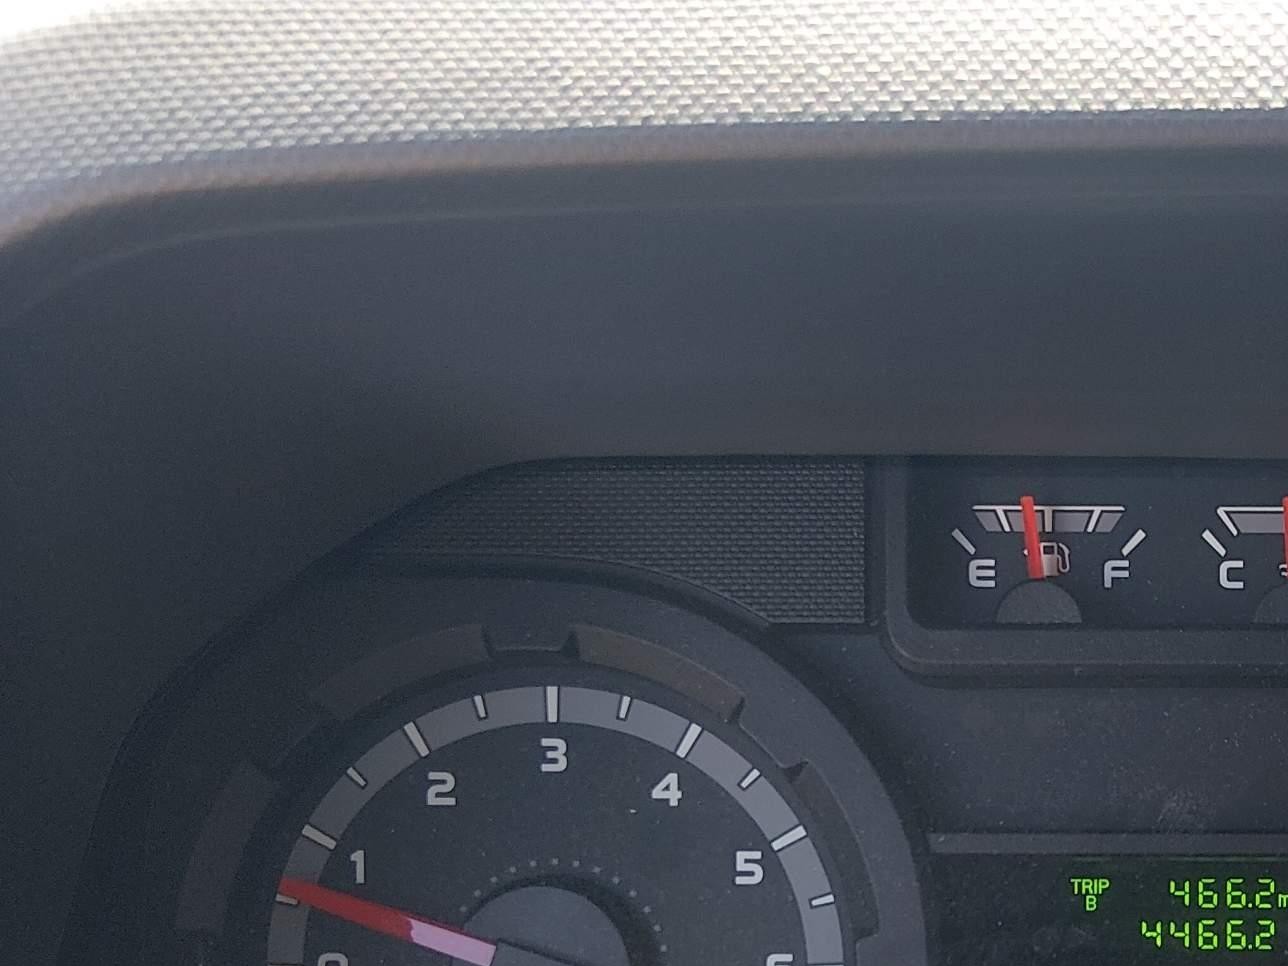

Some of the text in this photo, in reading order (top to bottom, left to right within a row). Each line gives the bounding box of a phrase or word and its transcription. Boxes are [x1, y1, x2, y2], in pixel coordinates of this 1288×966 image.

[969, 560, 1130, 588] E F
[1219, 560, 1244, 589] C
[541, 738, 568, 772] 3
[426, 772, 457, 806] 2
[651, 773, 682, 806] 4
[350, 850, 365, 884] 1
[735, 851, 763, 885] 5
[1070, 879, 1110, 895] TRIP
[1169, 878, 1275, 909] 466.2
[1085, 896, 1097, 911] B
[1141, 920, 1275, 950] 4466.2
